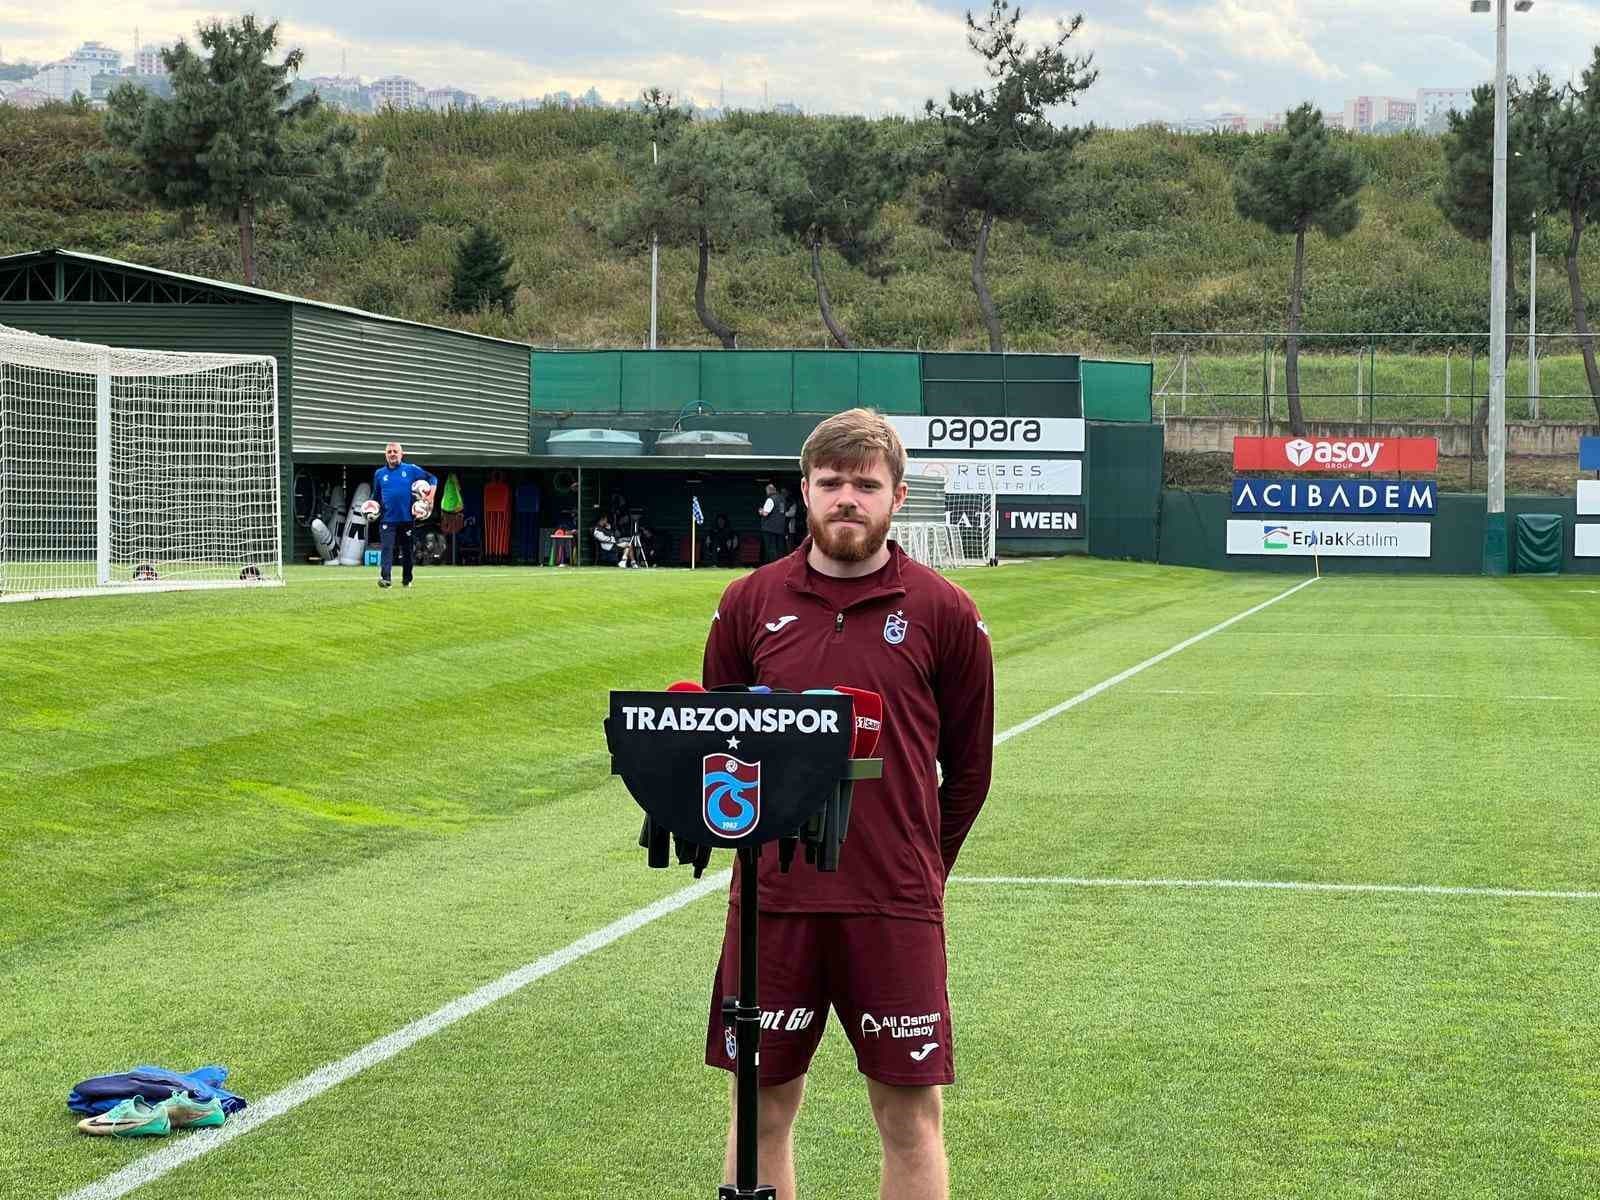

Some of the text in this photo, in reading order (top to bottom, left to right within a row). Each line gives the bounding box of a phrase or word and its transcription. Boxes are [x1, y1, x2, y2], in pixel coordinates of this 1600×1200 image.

[928, 418, 1041, 447] papara
[1314, 441, 1380, 468] asoy
[957, 464, 1042, 477] REGES
[1236, 483, 1433, 508] ACIBADEM
[1005, 511, 1077, 529] TWEEN
[622, 706, 839, 733] TRABZONSPOR
[785, 1007, 814, 1031] Go
[900, 1012, 941, 1027] Osman
[892, 1025, 934, 1038] Ulusoy
